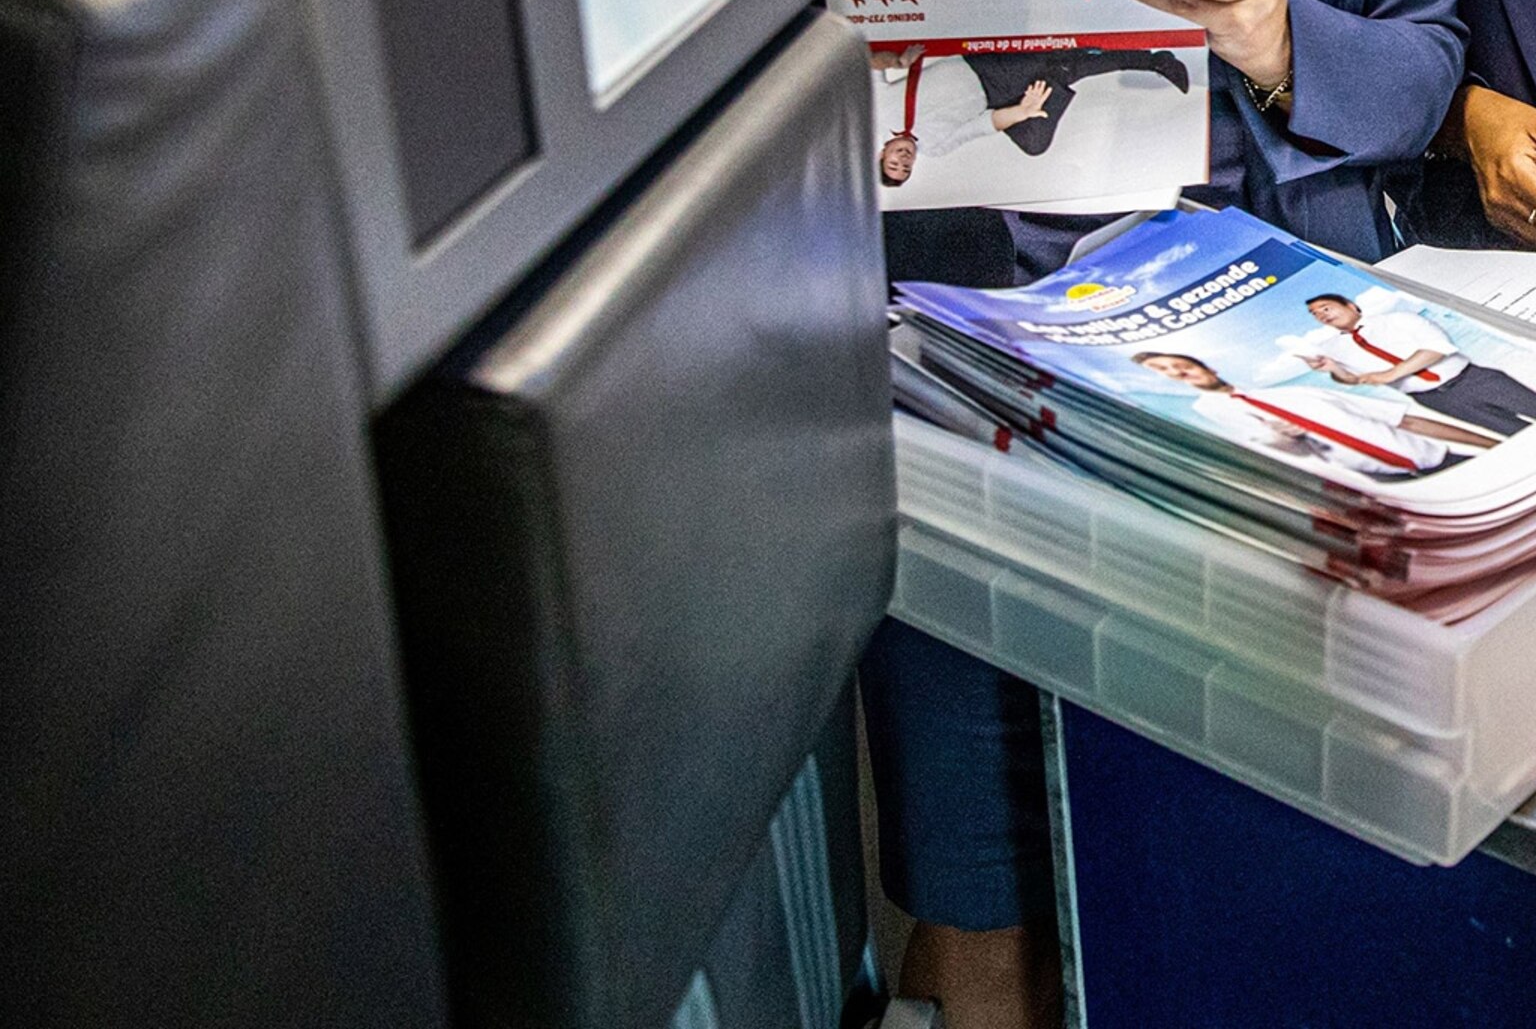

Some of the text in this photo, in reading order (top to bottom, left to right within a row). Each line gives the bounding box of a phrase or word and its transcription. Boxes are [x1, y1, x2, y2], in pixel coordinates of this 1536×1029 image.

[887, 12, 925, 23] BOEING
[997, 40, 1010, 50] de
[1012, 40, 1022, 50] in
[1168, 259, 1260, 311] gezonde
